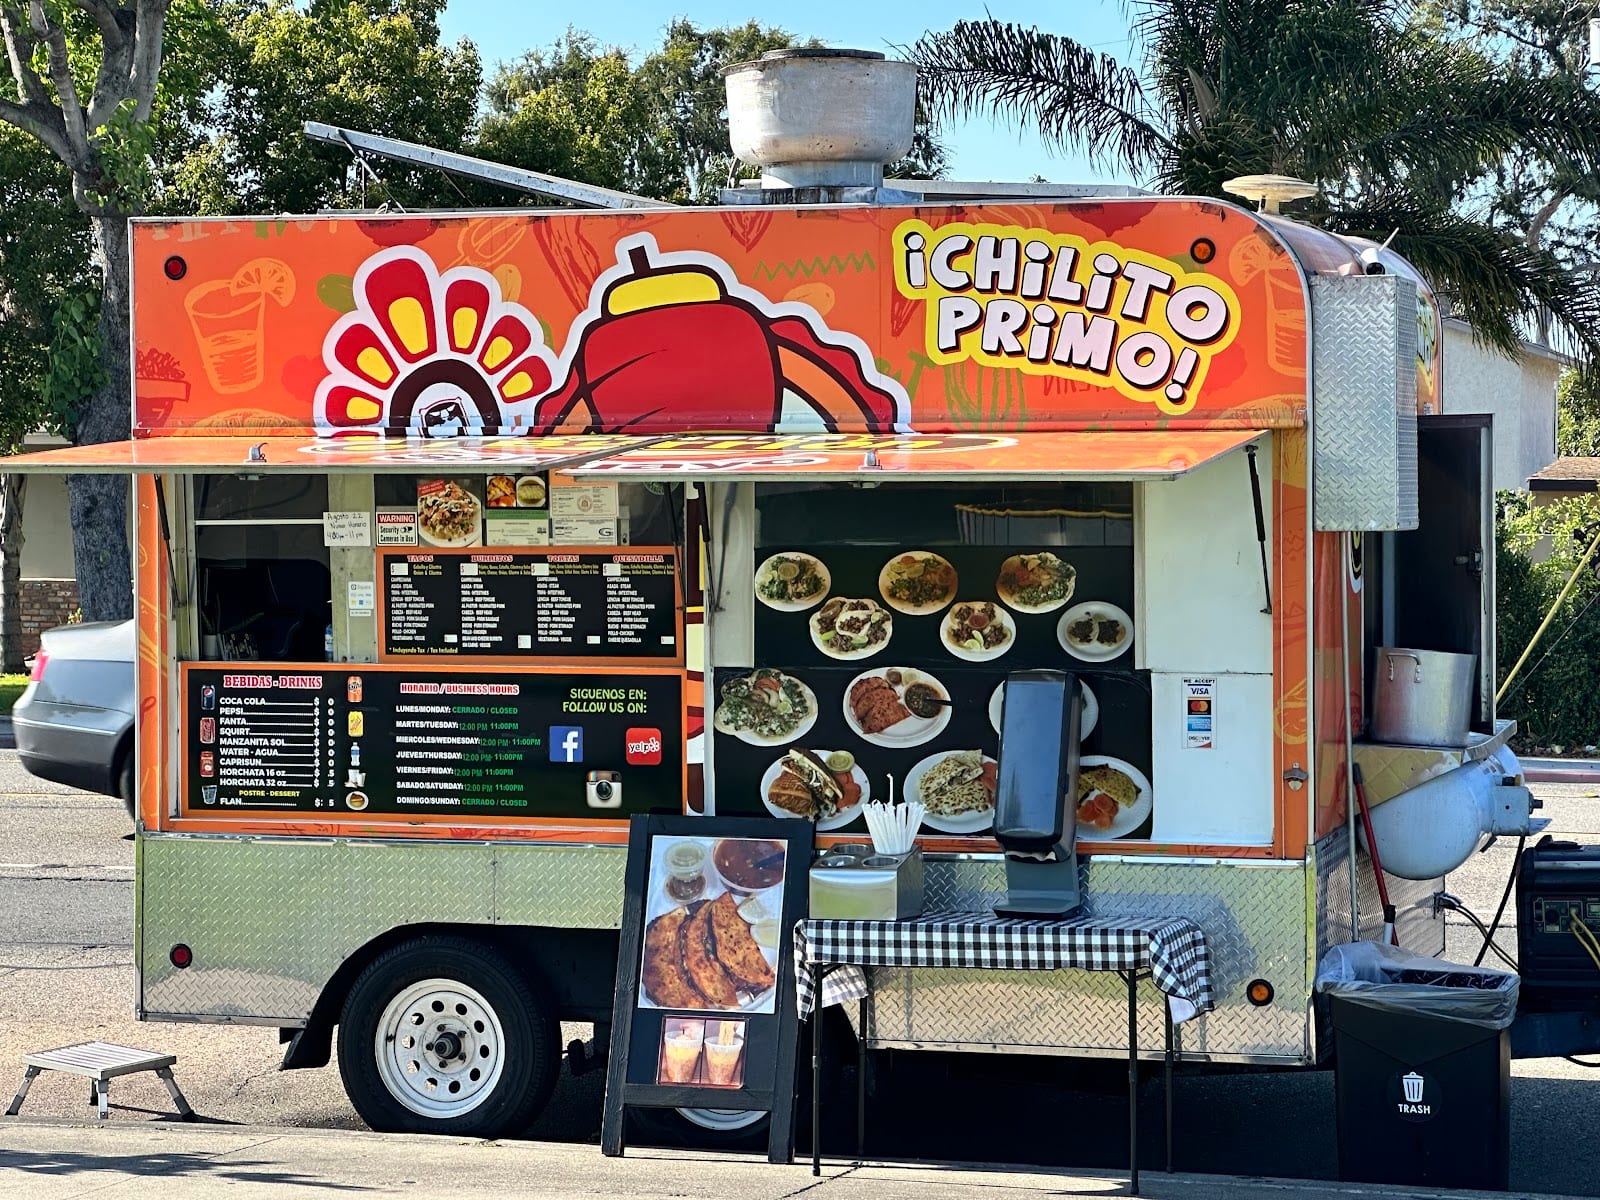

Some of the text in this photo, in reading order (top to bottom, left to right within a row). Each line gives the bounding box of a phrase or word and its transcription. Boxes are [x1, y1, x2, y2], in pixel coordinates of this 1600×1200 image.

[380, 526, 400, 534] Security
[612, 555, 664, 563] QUESADILLA
[223, 675, 272, 689] BEBIDAS
[280, 675, 322, 689] DRINKS
[400, 683, 439, 694] HORARIO
[446, 683, 489, 694] BUSINESS
[489, 683, 520, 694] HOURS
[570, 689, 647, 700] SIGUENOS EN:
[220, 697, 242, 705] COCA
[313, 697, 320, 707] $
[313, 707, 320, 717] $
[396, 705, 451, 713] LUNES/MONDAY:
[562, 702, 647, 713] FOLLOW US ON:
[313, 717, 320, 727] $
[396, 721, 459, 729] MARTES/TUESDAY:
[313, 727, 320, 737] $
[220, 738, 269, 746] MANZANITA
[313, 737, 320, 747] $
[396, 736, 480, 744] MIERCOLES/WEDNESDAY:
[220, 748, 249, 756] WATER
[313, 747, 320, 757] $
[628, 741, 650, 754] yelp
[396, 752, 462, 760] JUEVES/THURSDAY:
[313, 758, 320, 768] $
[220, 769, 265, 777] HORCHATA
[266, 769, 274, 777] 16
[313, 768, 320, 778] $
[396, 766, 454, 774] VIERNES/FRIDAY:
[220, 779, 265, 787] HORCHATA
[266, 779, 275, 787] 32
[313, 778, 320, 788] $
[396, 782, 463, 790] SABADO/SATURDAY:
[397, 797, 460, 805] DOMINGO/SUNDAY:
[1398, 1104, 1430, 1114] TRASH
